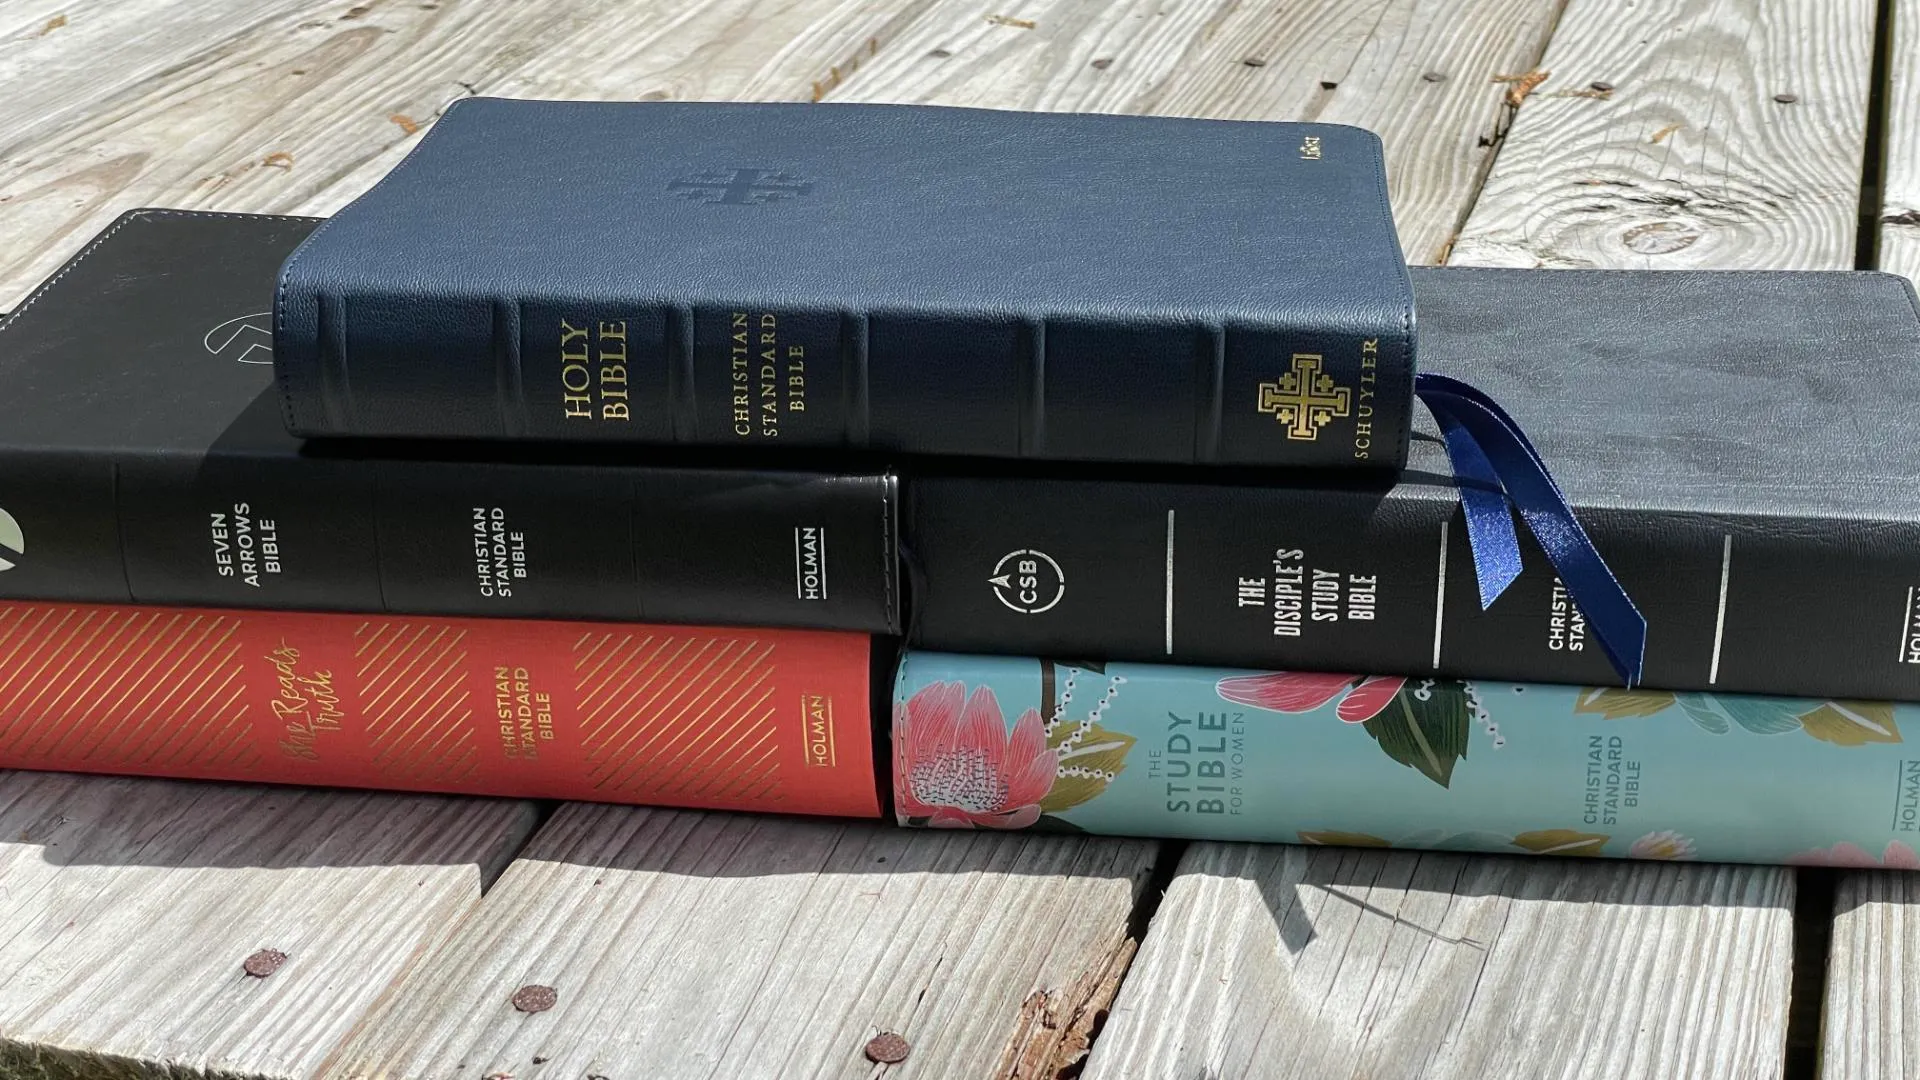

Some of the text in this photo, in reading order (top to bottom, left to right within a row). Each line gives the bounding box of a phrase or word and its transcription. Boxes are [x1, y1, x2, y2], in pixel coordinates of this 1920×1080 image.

[561, 318, 592, 420] HOLY
[599, 320, 630, 421] BIBLE
[732, 312, 750, 436] CHRISTIAN
[761, 313, 778, 437] STANDARD
[789, 345, 805, 411] BIBLE
[1355, 338, 1378, 459] SCHUYLER
[210, 513, 234, 576] SEVEN
[234, 502, 260, 587] ARROWS
[259, 519, 281, 573] BIBLE
[473, 507, 494, 597] CHRISTIAN
[491, 507, 512, 597] STANDARD
[510, 532, 527, 578] BIBLE
[803, 527, 819, 599] HOLMAN
[1019, 560, 1037, 604] CSB
[1238, 576, 1266, 607] THE
[1273, 549, 1304, 637] DISCIPLE'S
[1311, 568, 1340, 622] STUDY
[1348, 574, 1377, 620] BIBLE
[1549, 577, 1567, 650] CHRISTI
[1569, 603, 1585, 651] STAN
[264, 637, 308, 720] Reads
[297, 669, 344, 736] Truth
[536, 692, 554, 740] BIBLE
[811, 695, 828, 767] HOLMAN
[1148, 750, 1161, 779] THE
[1167, 710, 1192, 813] STUDY
[1197, 711, 1227, 814] BIBLE
[1230, 712, 1245, 815] FOR WOMEN
[1583, 735, 1602, 824] CHRISTIAN
[1603, 736, 1622, 825] STANDARD
[1624, 761, 1641, 807] BIBLE
[1900, 760, 1920, 832] HOLMAN
